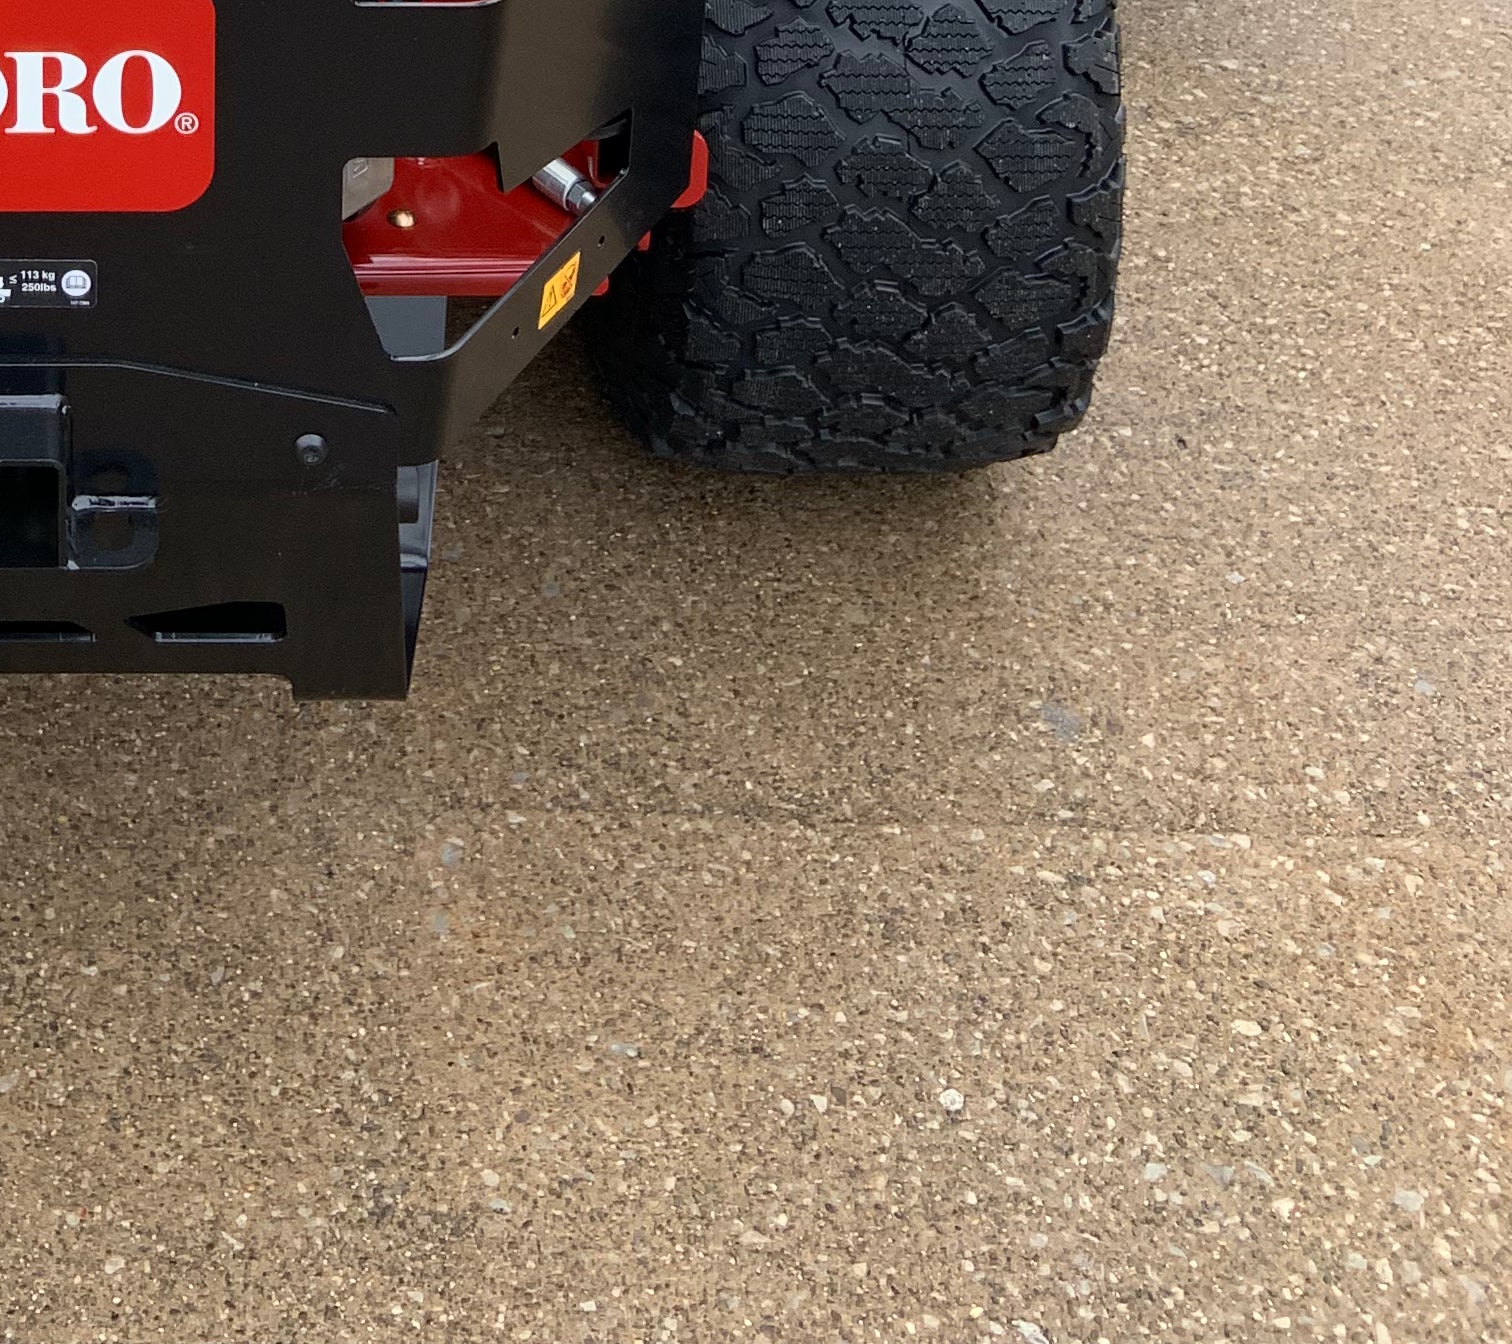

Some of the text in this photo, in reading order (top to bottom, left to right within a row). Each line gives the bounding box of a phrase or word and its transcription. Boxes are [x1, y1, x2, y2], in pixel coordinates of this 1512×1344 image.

[20, 270, 39, 279] 113
[41, 270, 56, 281] kg
[21, 282, 57, 292] 250lbs
